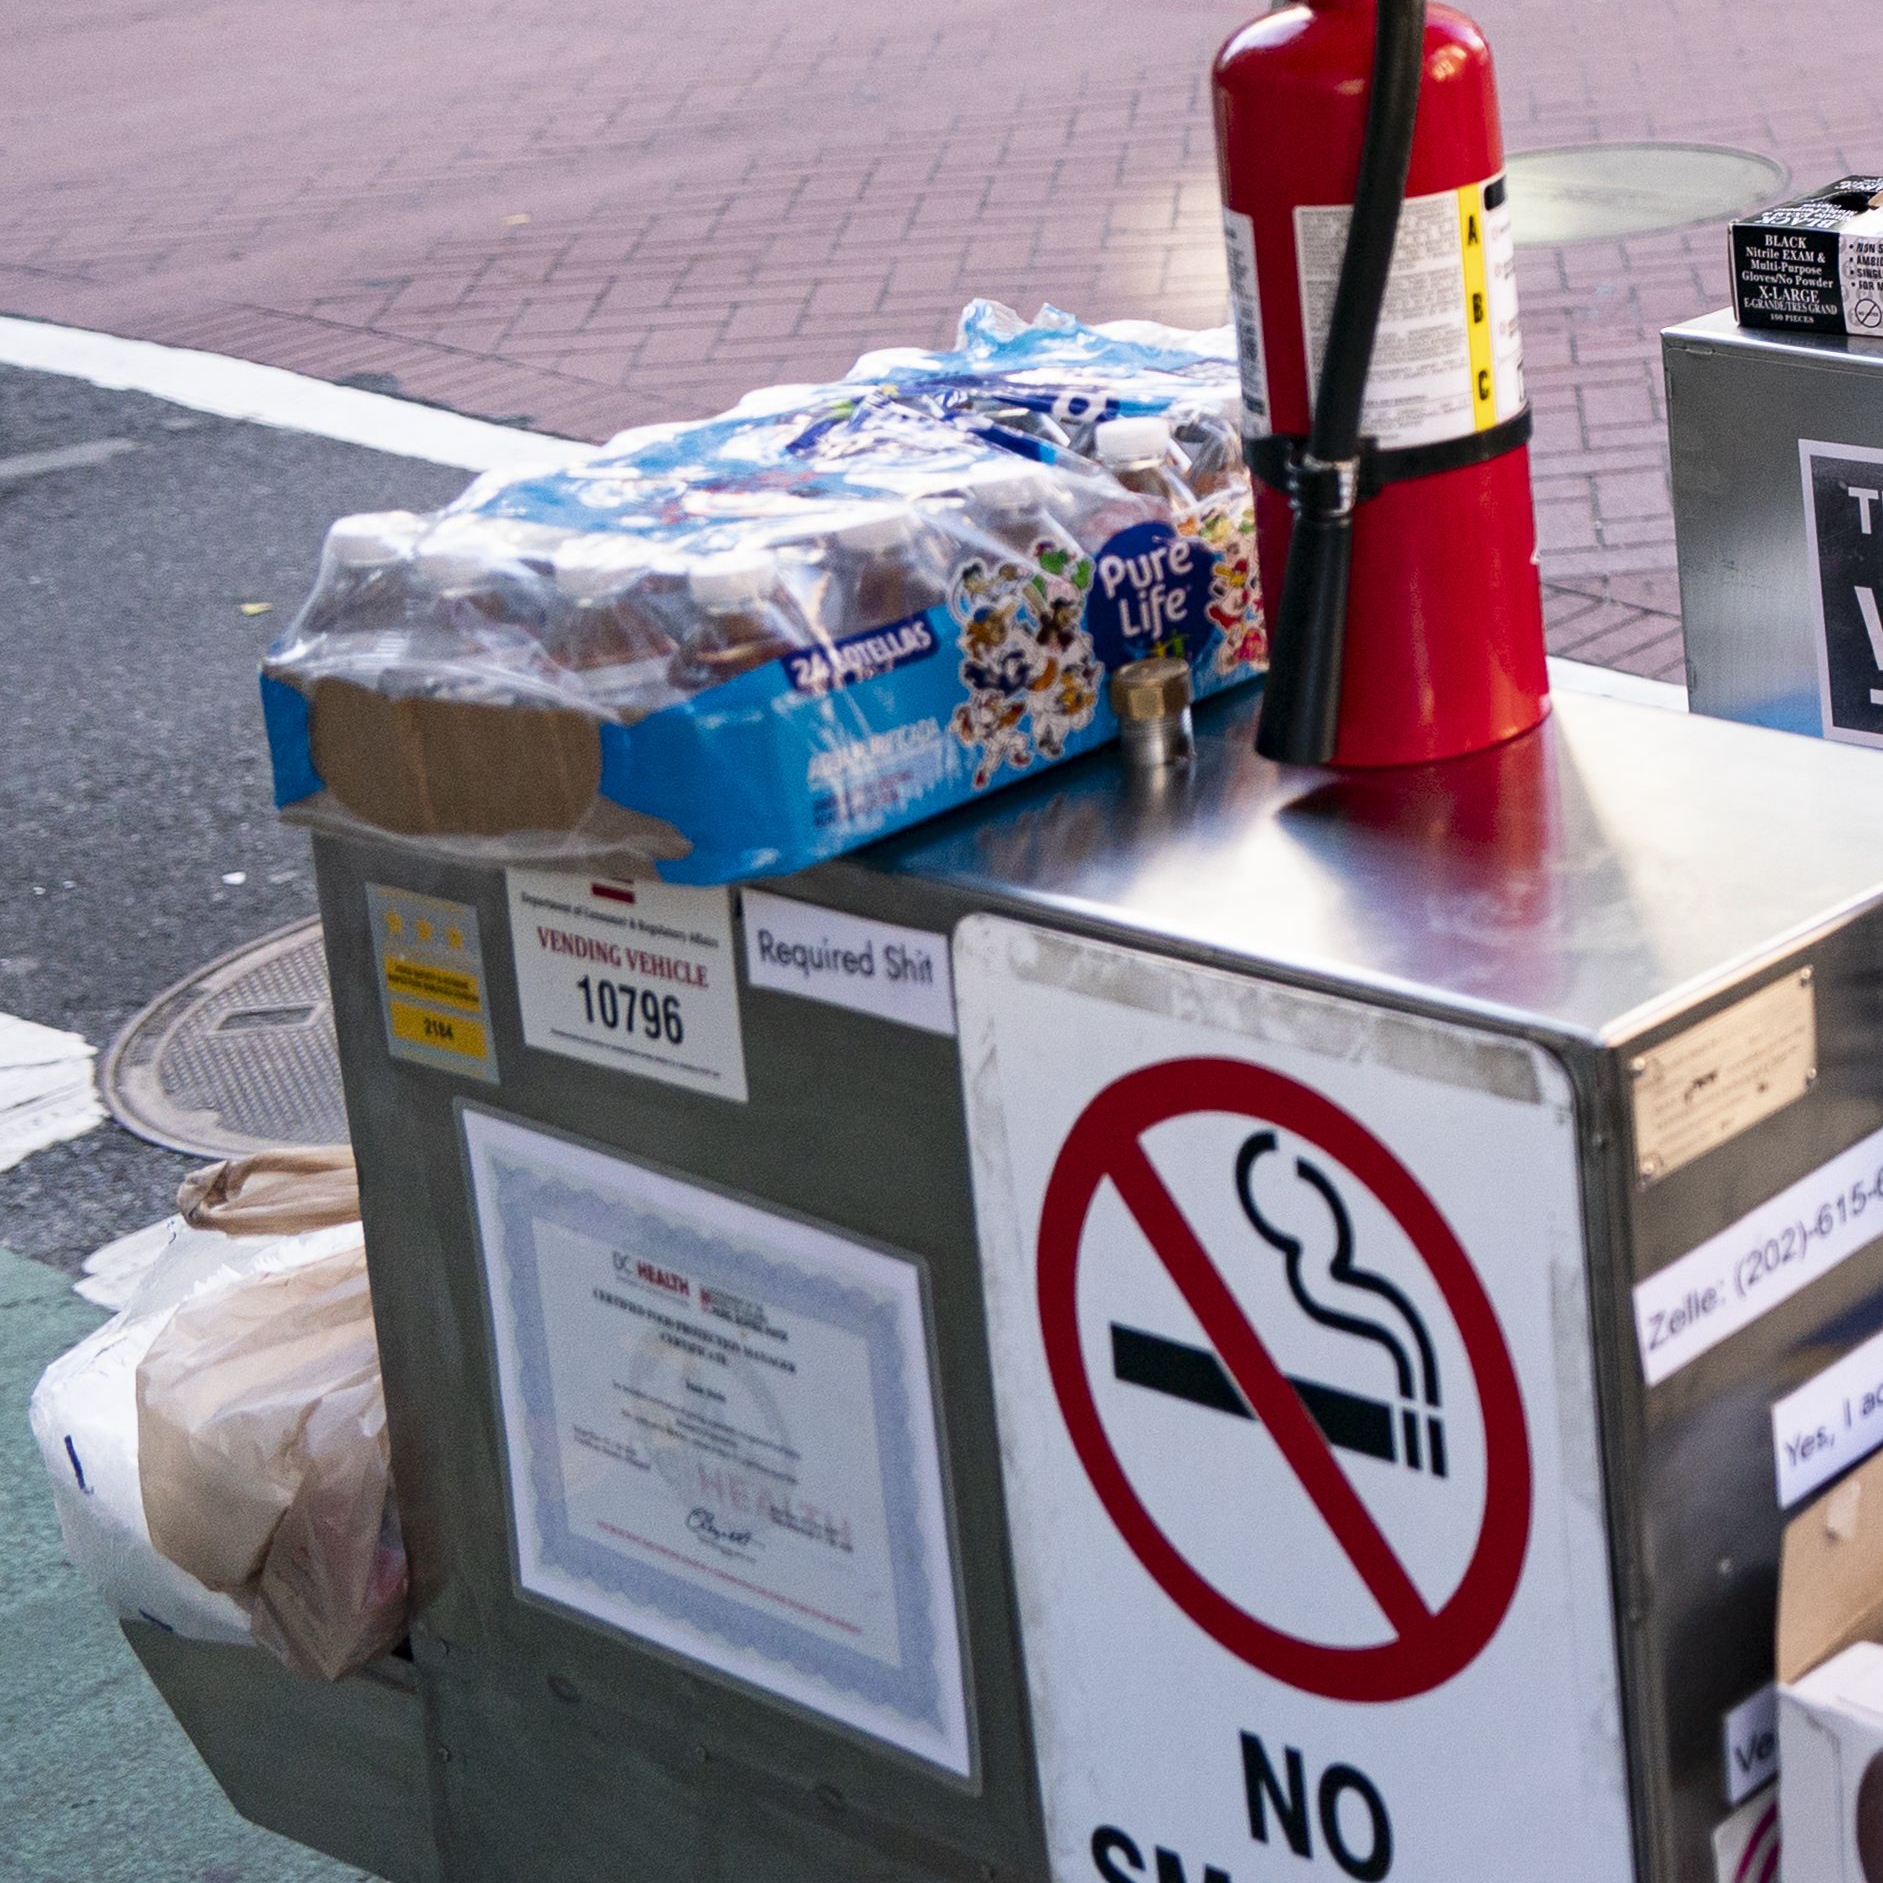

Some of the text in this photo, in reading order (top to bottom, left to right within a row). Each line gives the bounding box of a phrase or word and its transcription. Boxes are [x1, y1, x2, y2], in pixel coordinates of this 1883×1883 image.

[1746, 247, 1826, 263] Nitrile EXAM &
[1765, 235, 1807, 248] BLACK
[1856, 243, 1876, 253] NON
[1742, 270, 1834, 288] Gloves/No Powder
[1751, 259, 1822, 276] Multi-Purpose
[1859, 281, 1875, 291] FOR
[1467, 214, 1489, 401] A B C
[1759, 285, 1820, 303] X-LARGE
[1808, 304, 1838, 315] GRAND
[1785, 313, 1814, 324] PIECES
[1099, 541, 1194, 600] Pure
[1119, 584, 1188, 640] Life
[790, 650, 833, 686] 24
[537, 925, 709, 988] VENDING VEHICLE
[757, 928, 934, 985] Required Shit
[576, 973, 685, 1045] 10796
[636, 1259, 690, 1297] HEALTH
[1649, 1279, 1727, 1351] Zelle:
[1785, 1424, 1836, 1466] Yes,
[1843, 1397, 1852, 1429] I
[1239, 1728, 1395, 1883] NO
